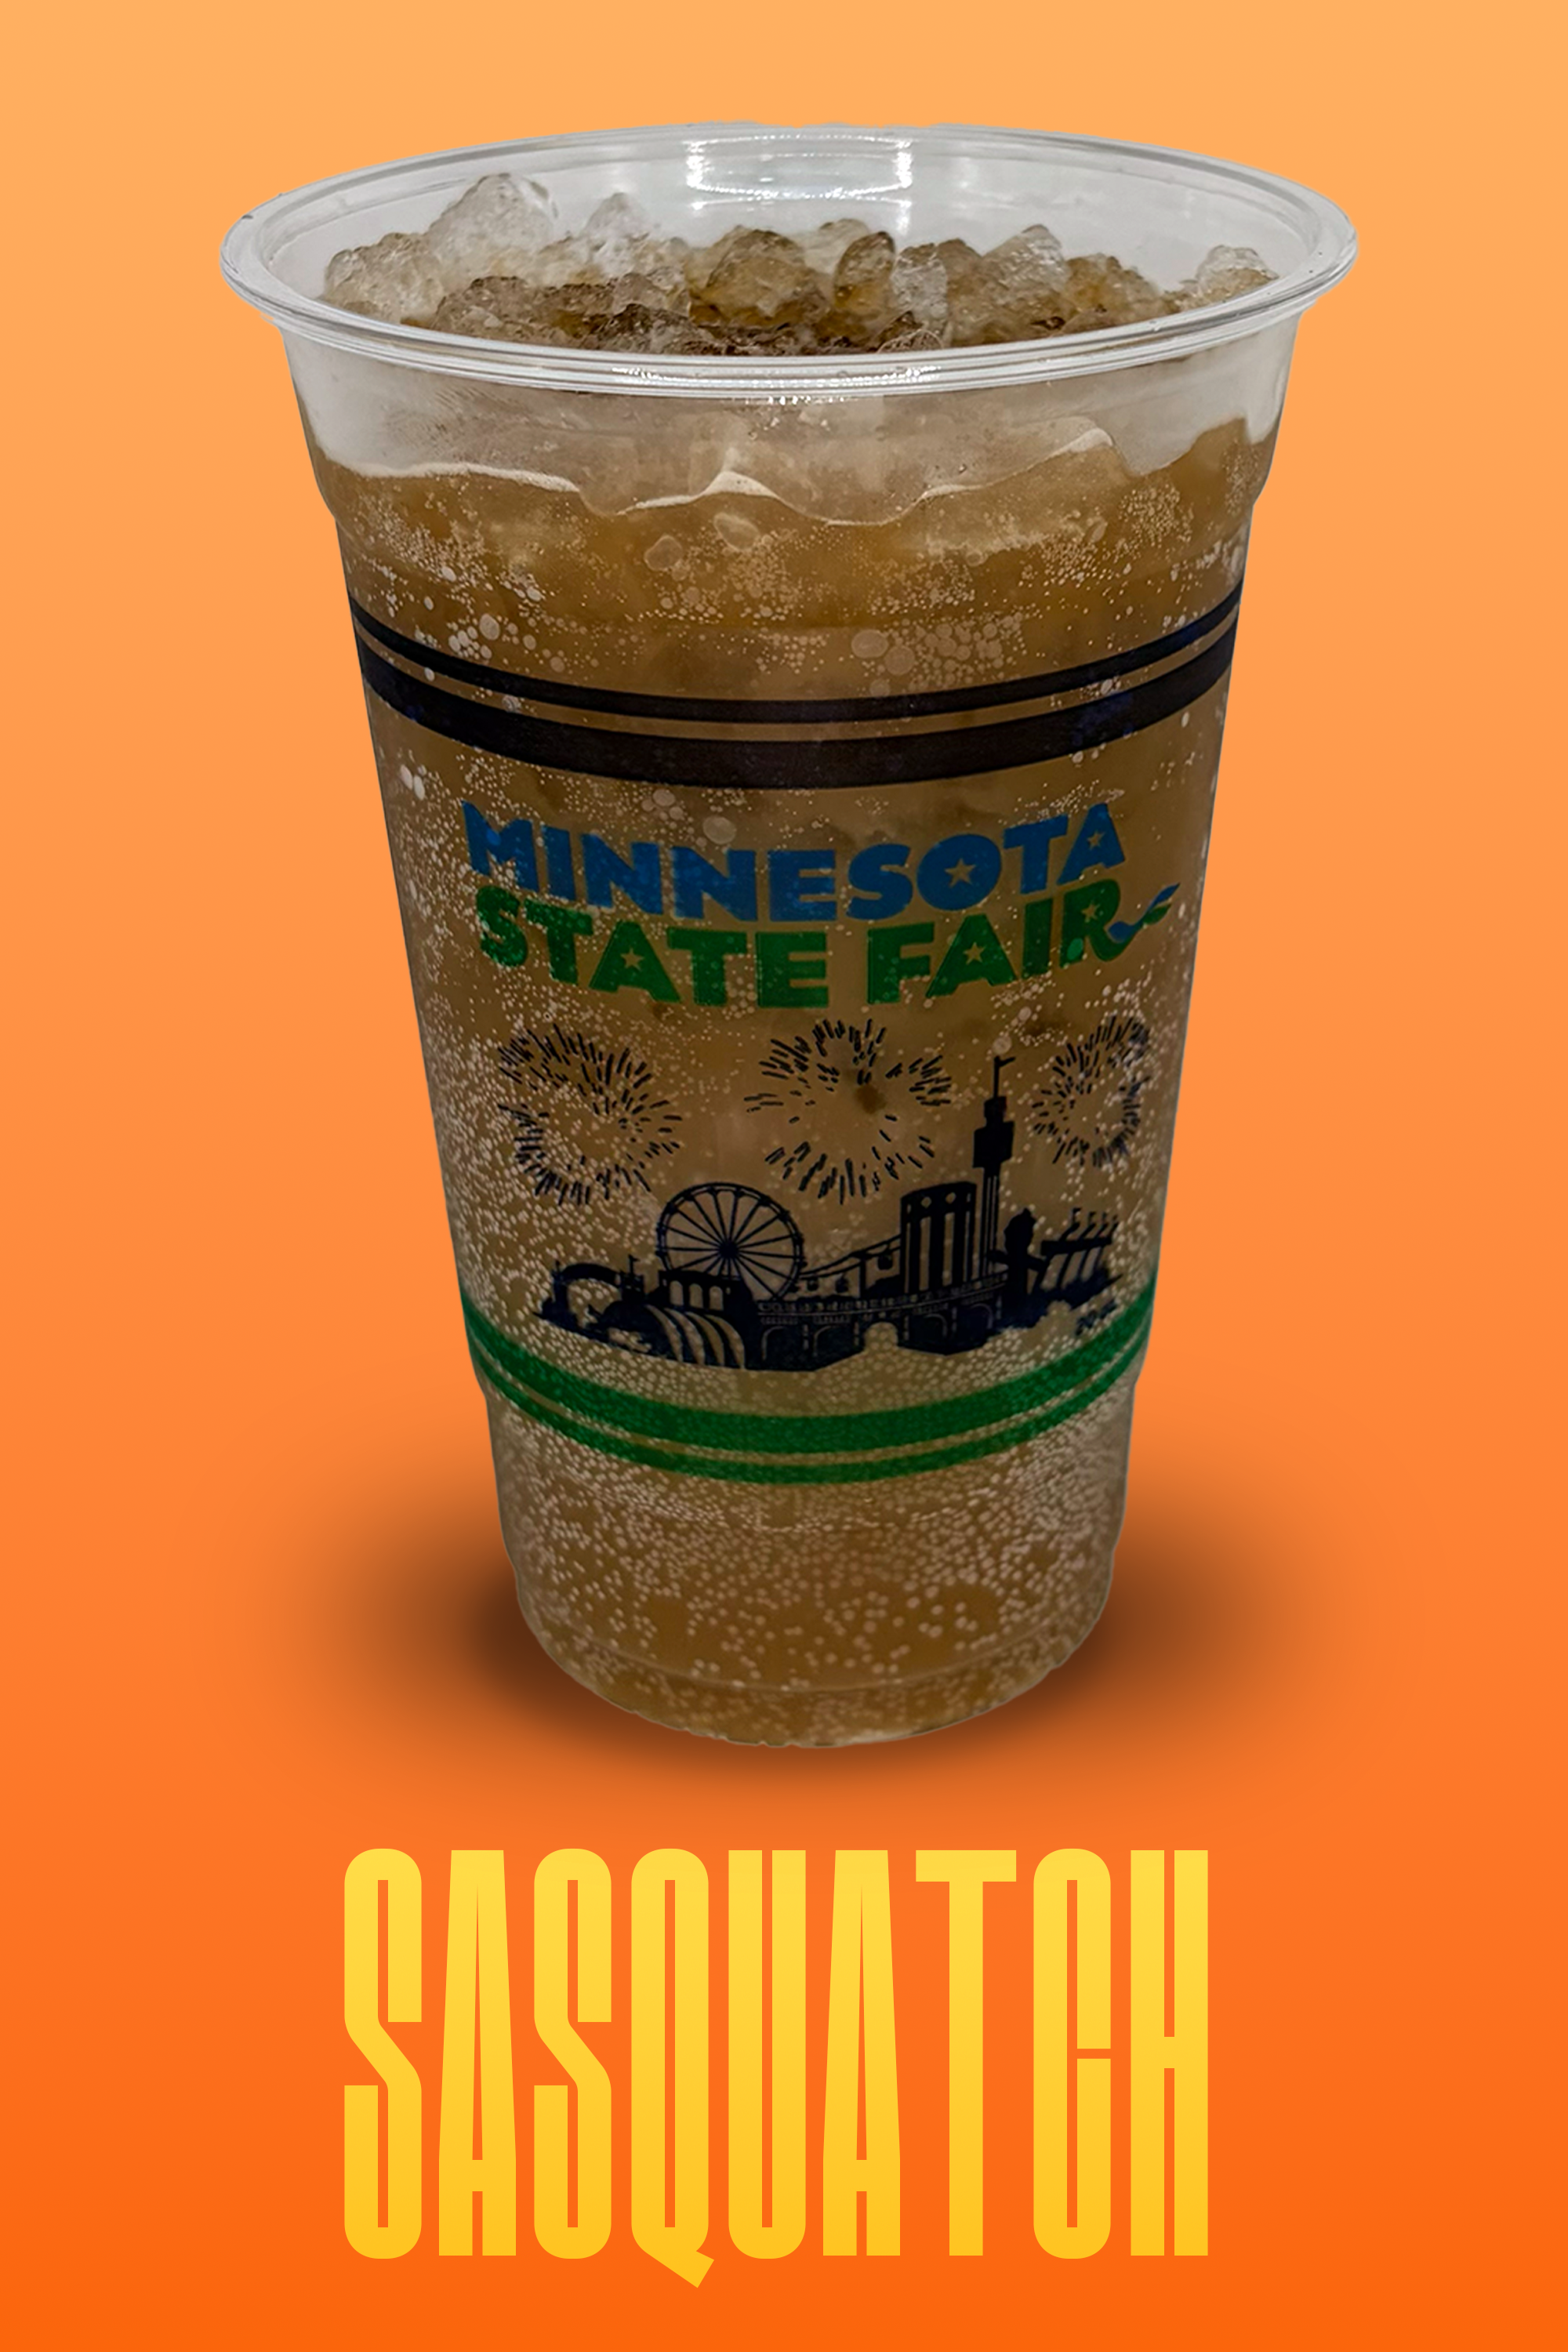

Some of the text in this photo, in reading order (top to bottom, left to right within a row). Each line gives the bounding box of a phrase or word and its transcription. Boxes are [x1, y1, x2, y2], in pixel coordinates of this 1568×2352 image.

[461, 800, 1126, 922] MINNESOTA
[474, 877, 1181, 1008] STATE FAIR
